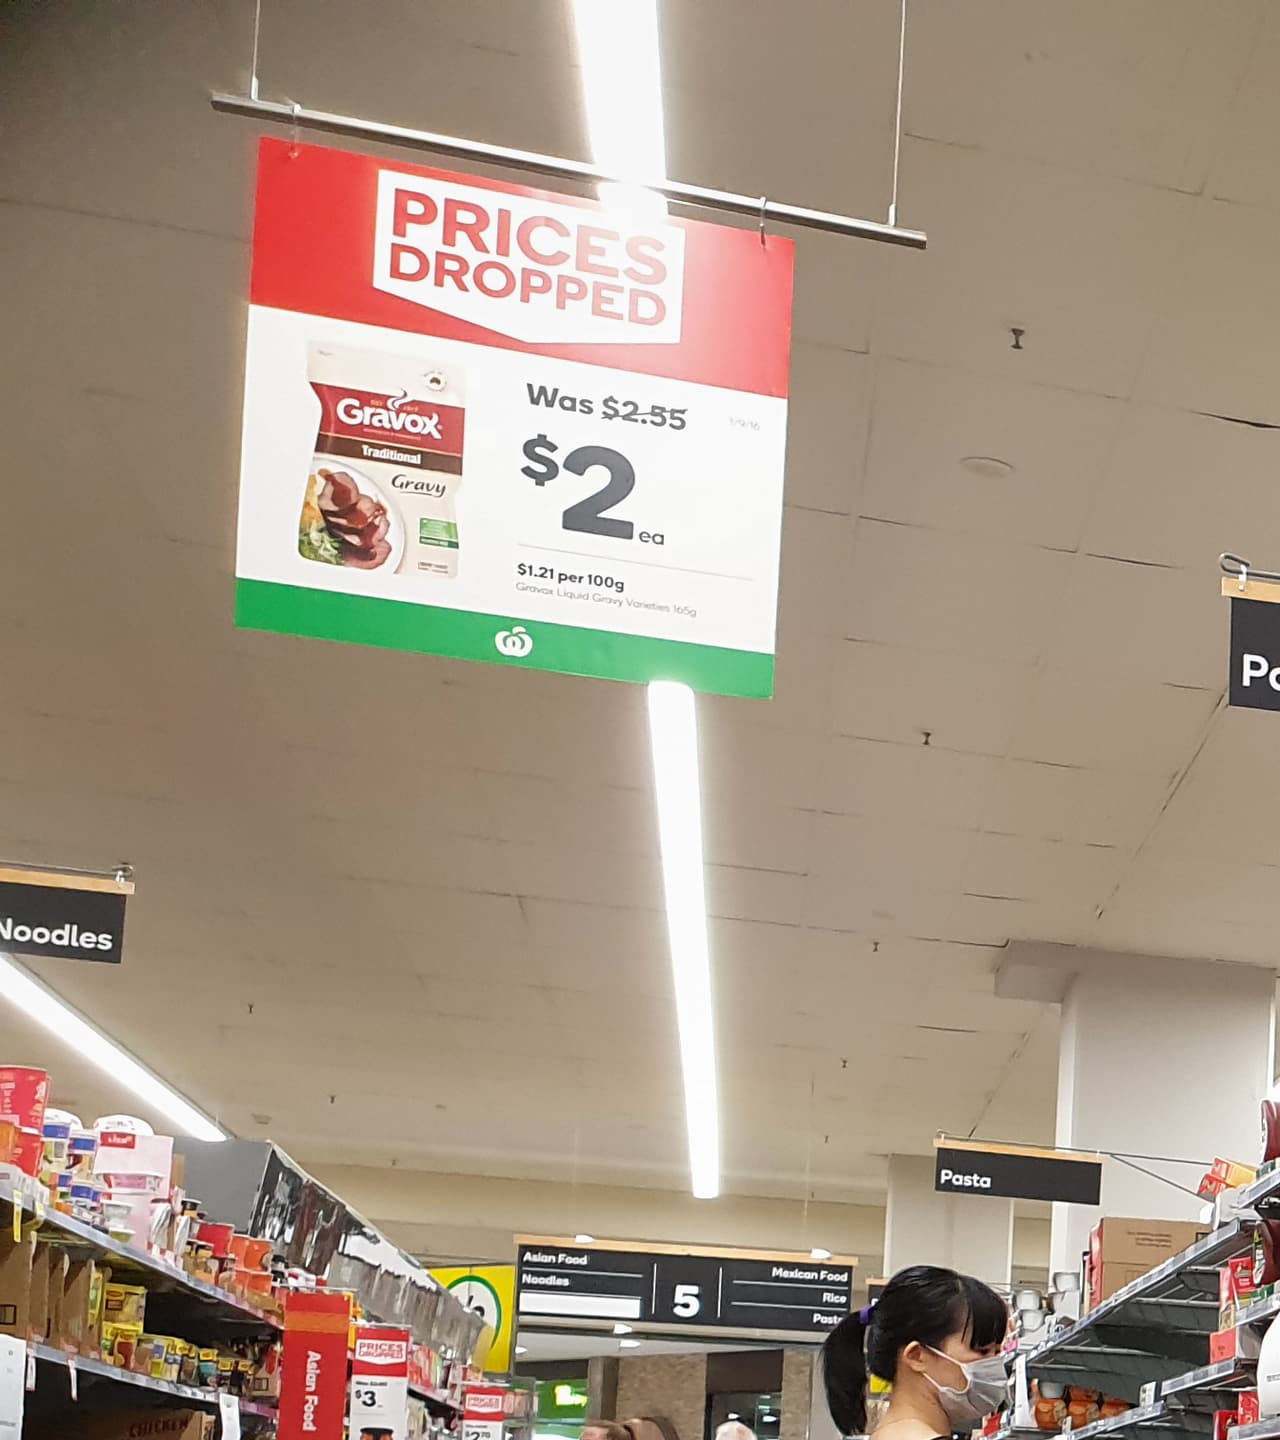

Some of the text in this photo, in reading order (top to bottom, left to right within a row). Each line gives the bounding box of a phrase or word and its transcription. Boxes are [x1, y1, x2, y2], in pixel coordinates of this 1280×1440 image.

[392, 187, 668, 287] PRICES
[388, 243, 667, 327] DROPPED
[336, 398, 442, 439] Gravox
[526, 383, 688, 430] Was $2.55
[362, 444, 421, 465] Traditional
[391, 473, 447, 498] Gravy
[520, 433, 665, 546] $2 ea
[517, 563, 625, 593] $1.21 per 100g
[0, 918, 113, 950] Noodles
[940, 1168, 991, 1189] Pasta
[522, 1252, 588, 1266] Asian Food
[521, 1274, 569, 1288] Noodles
[771, 1267, 848, 1282] Mexican Food
[673, 1284, 700, 1318] 5
[822, 1292, 847, 1304] Rice
[302, 1350, 322, 1432] Asian Food
[129, 1417, 189, 1438] CHICKEN
